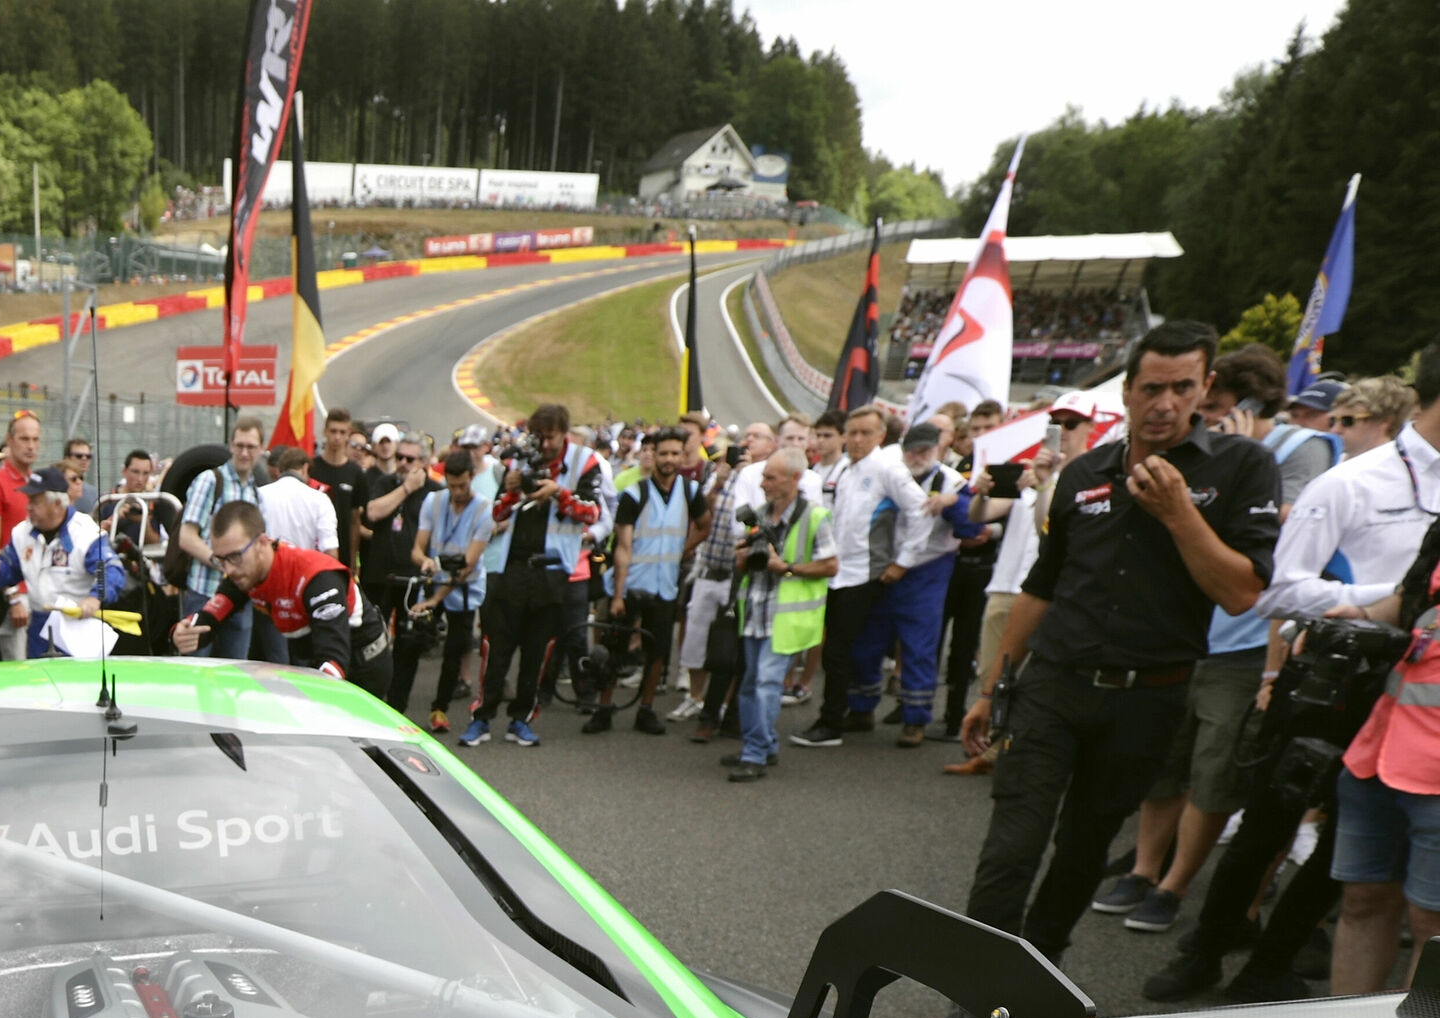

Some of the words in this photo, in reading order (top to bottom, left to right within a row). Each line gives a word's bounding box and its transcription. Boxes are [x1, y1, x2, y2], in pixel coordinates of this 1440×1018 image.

[250, 0, 298, 165] WR
[376, 174, 424, 190] CIRCUIT
[428, 176, 445, 190] DE
[448, 176, 472, 191] SPA
[24, 813, 158, 860] Audi
[177, 803, 343, 857] Sport
